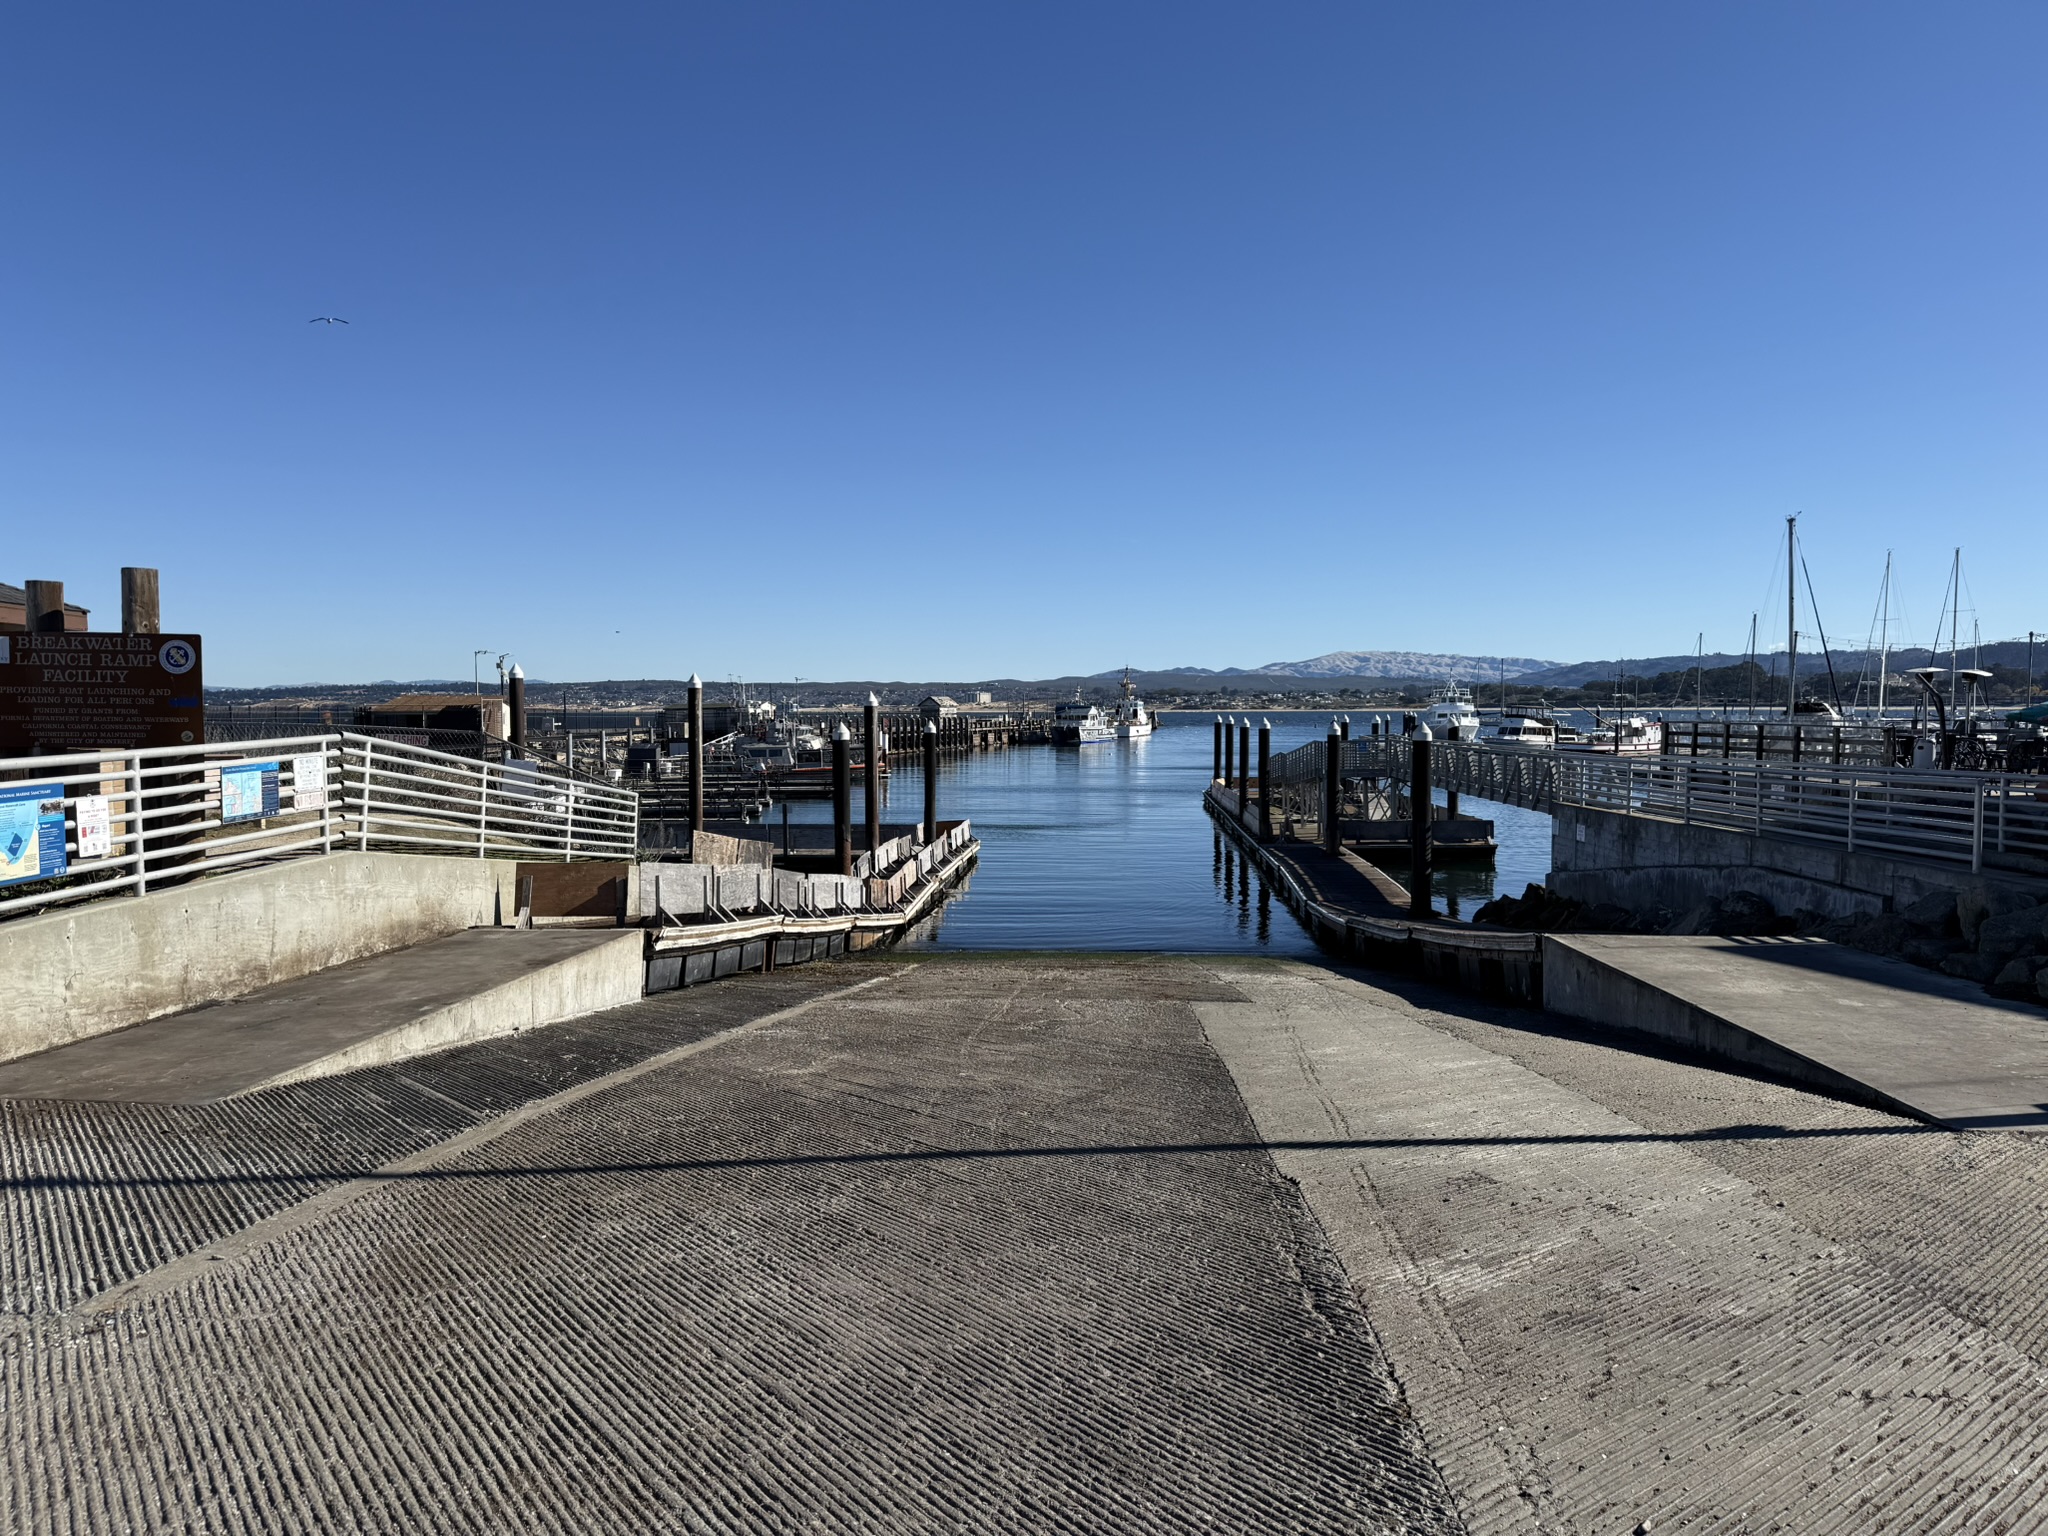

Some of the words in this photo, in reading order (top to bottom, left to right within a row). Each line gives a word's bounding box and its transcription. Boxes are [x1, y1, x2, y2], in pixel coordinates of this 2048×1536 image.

[16, 636, 152, 650] BREAKWATER
[15, 652, 92, 666] LAUNCH
[100, 654, 157, 667] RAMP
[43, 669, 129, 682] FACILITY
[87, 688, 145, 696] LAUNCHING
[392, 734, 428, 748] FISHING
